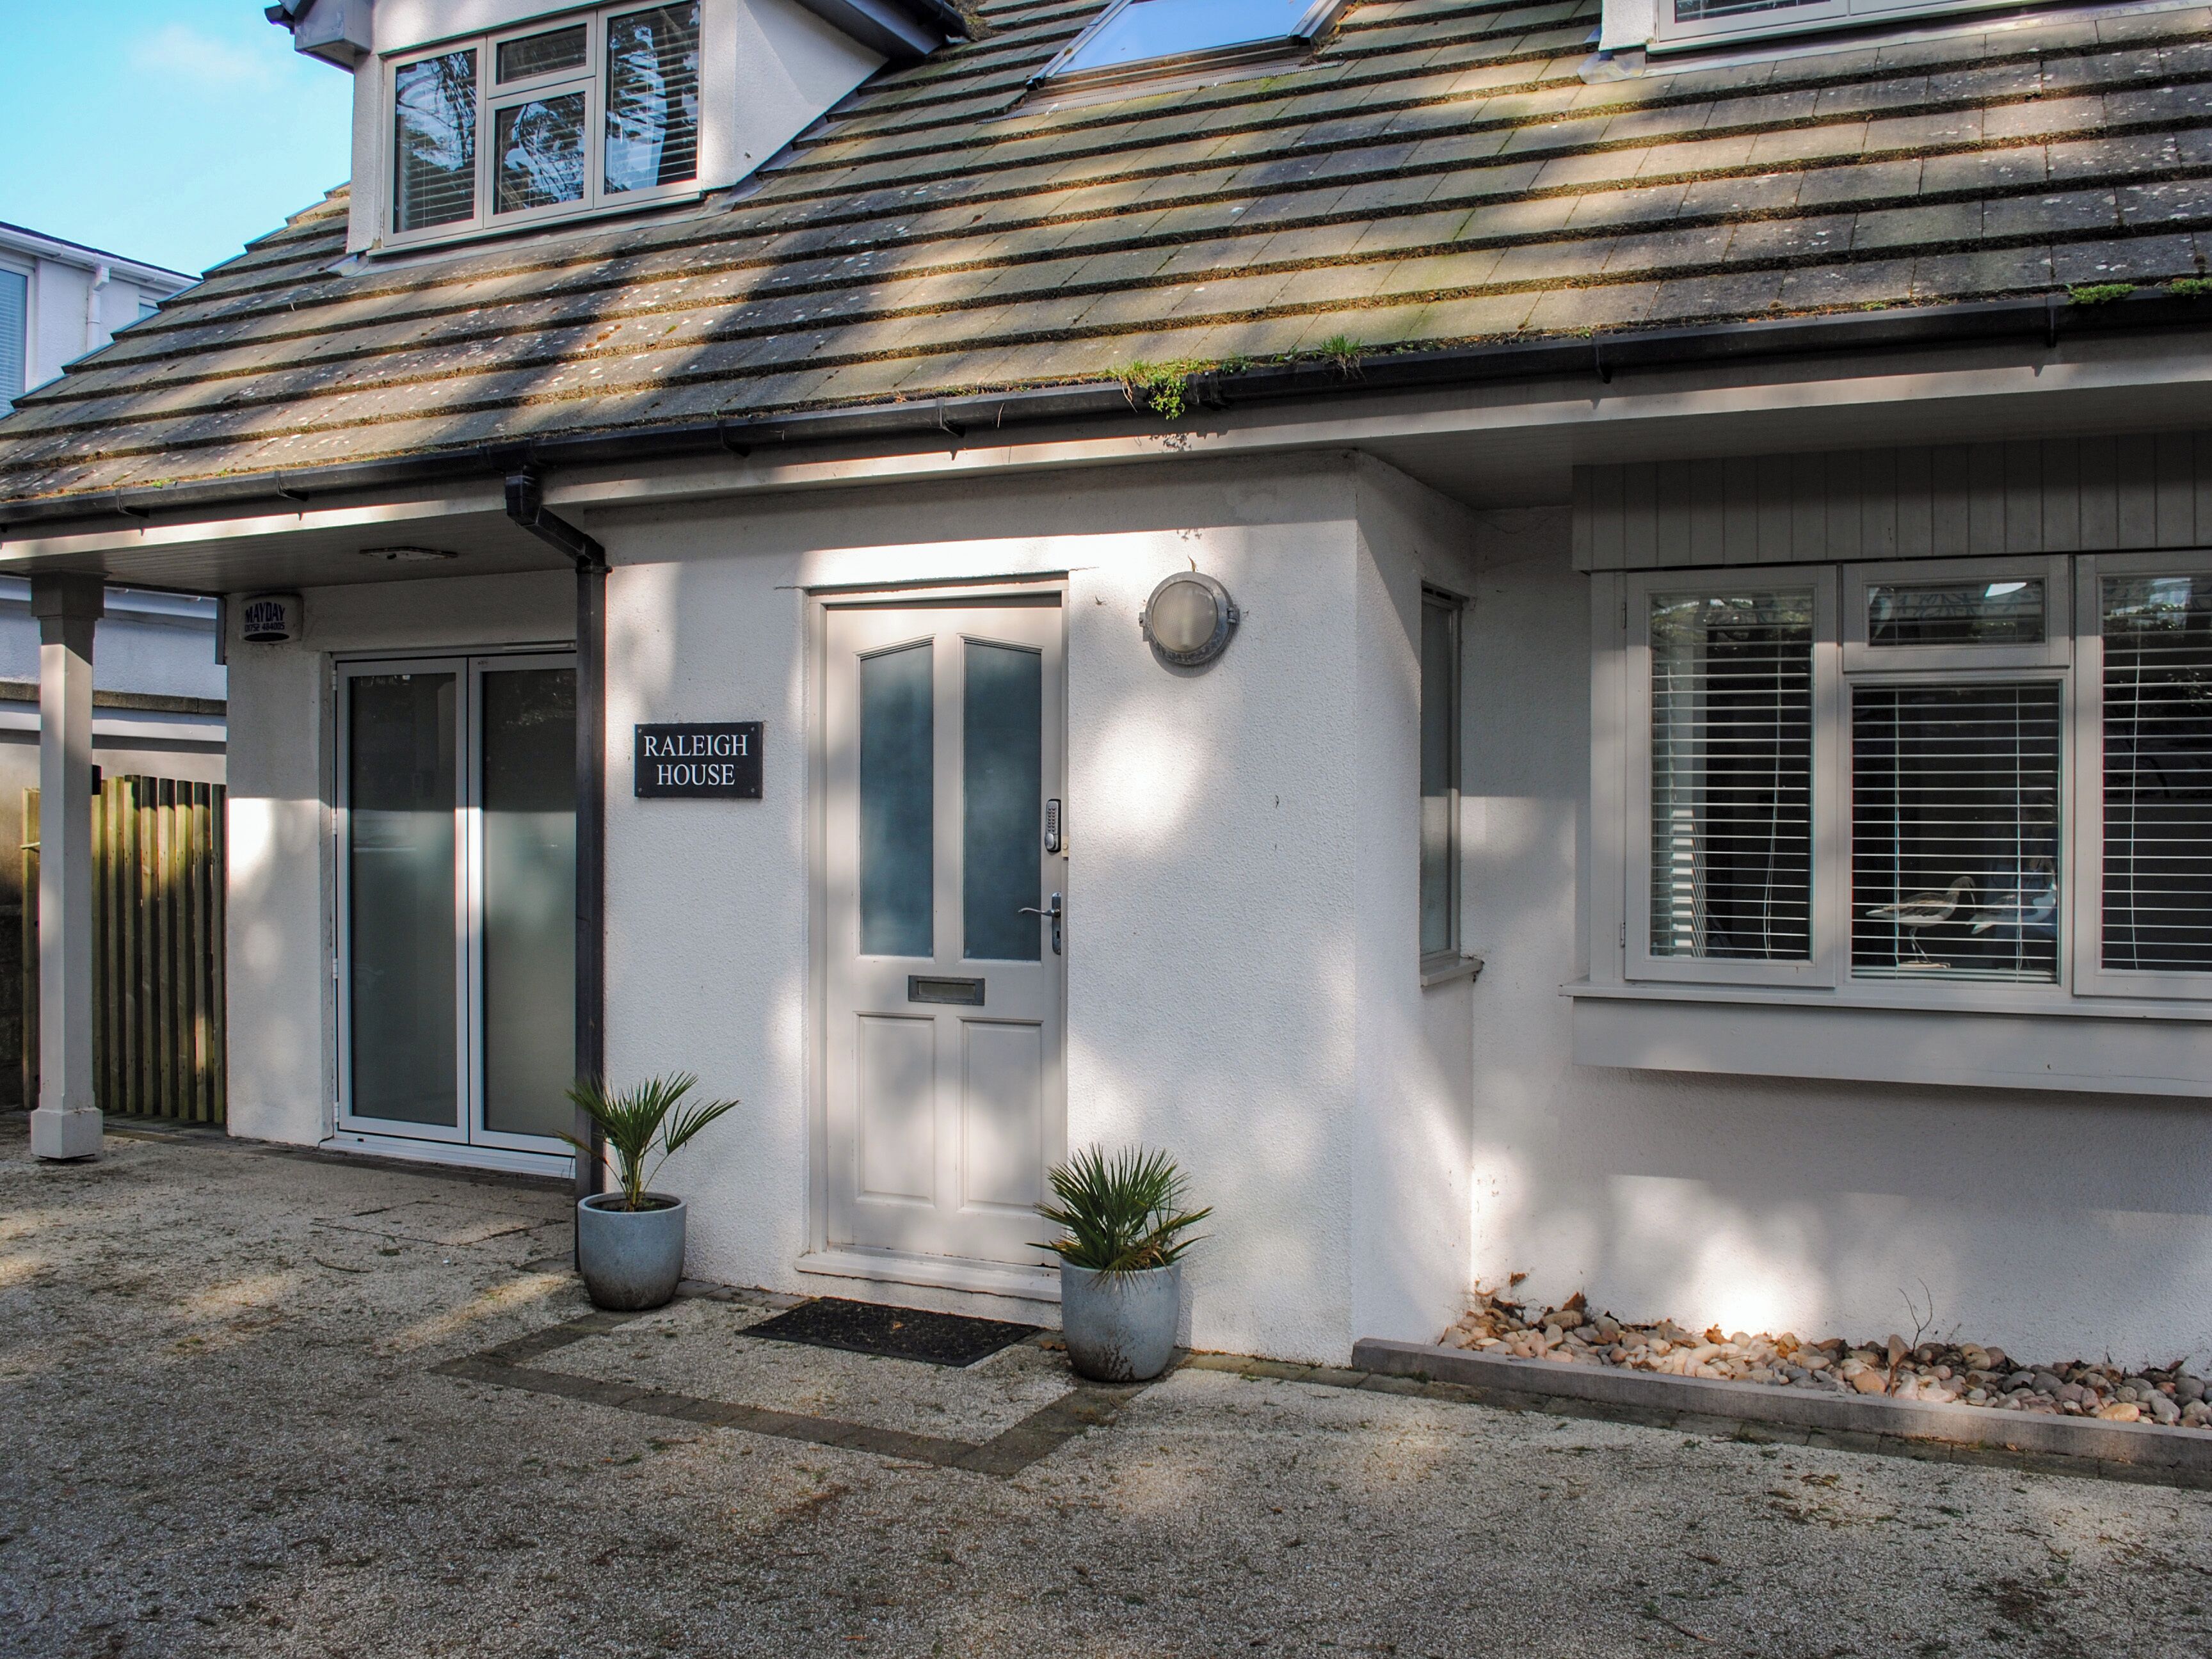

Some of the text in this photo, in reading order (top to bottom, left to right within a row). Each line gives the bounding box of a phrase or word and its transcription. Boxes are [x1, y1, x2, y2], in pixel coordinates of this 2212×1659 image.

[246, 602, 285, 623] MAYDAY
[644, 735, 748, 757] RALEIGH
[657, 764, 735, 785] HOUSE
